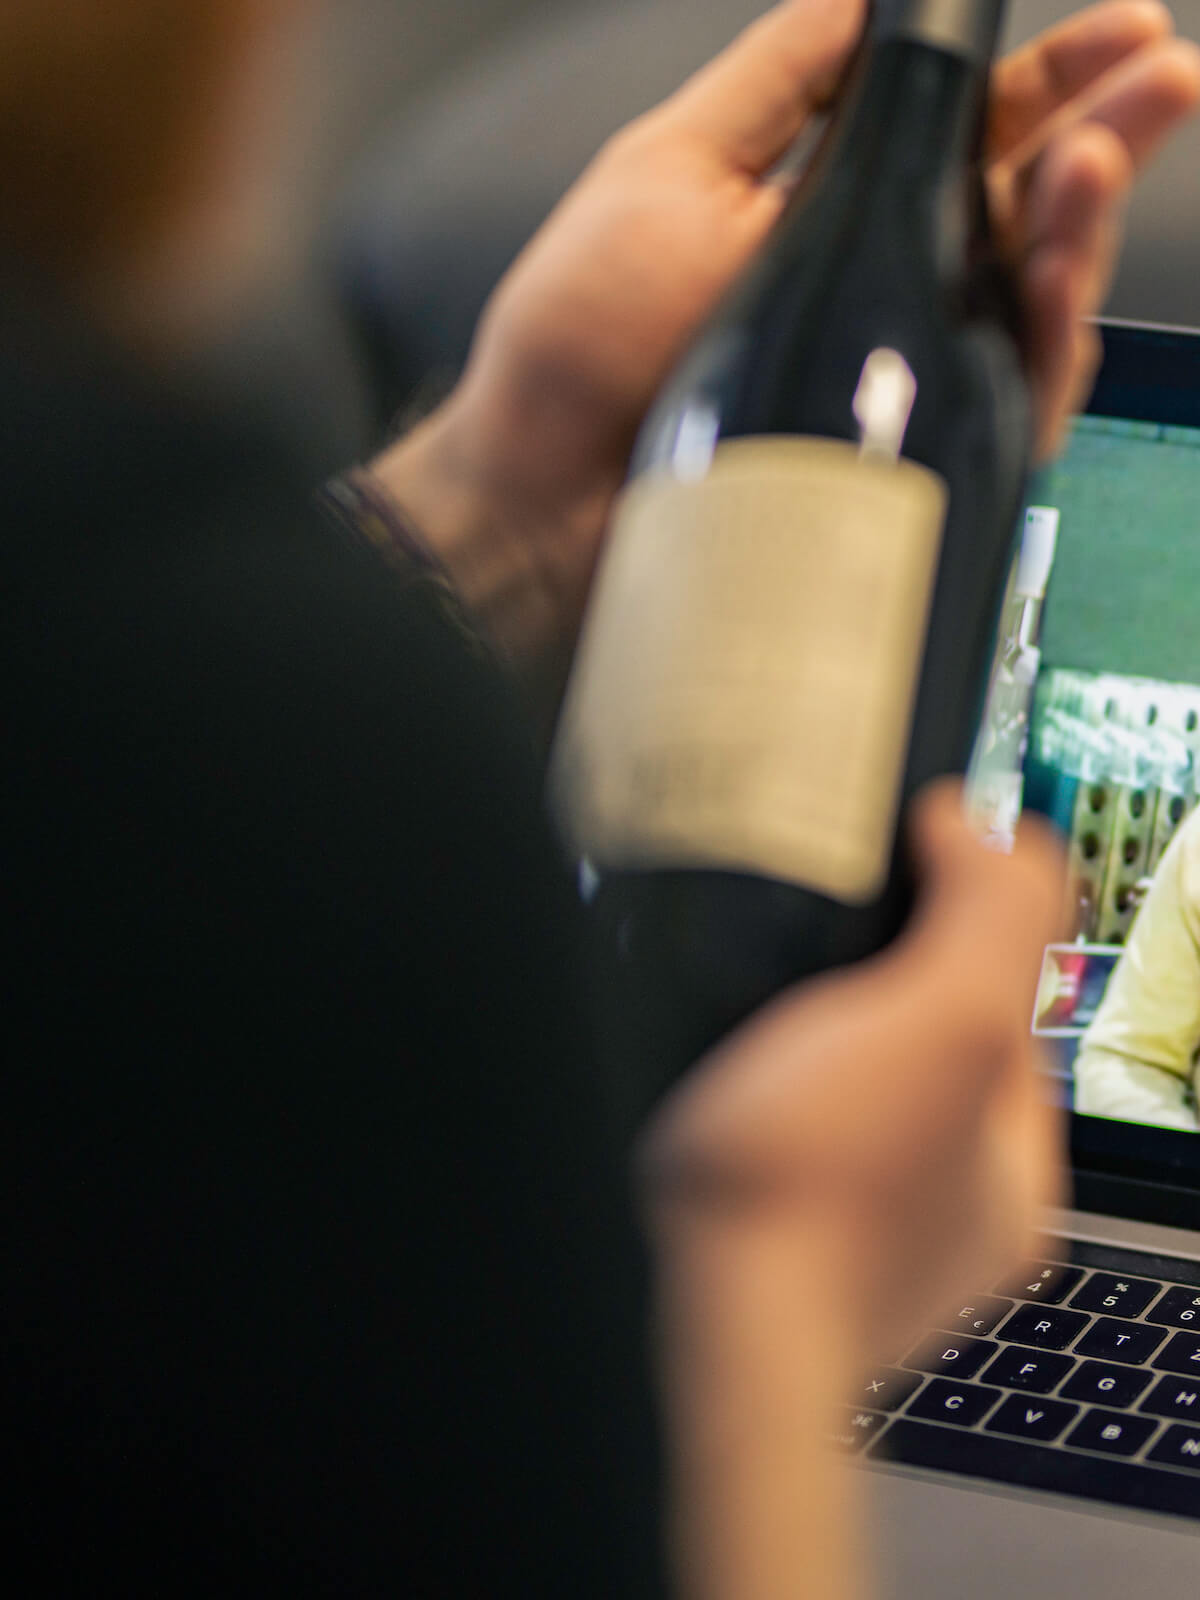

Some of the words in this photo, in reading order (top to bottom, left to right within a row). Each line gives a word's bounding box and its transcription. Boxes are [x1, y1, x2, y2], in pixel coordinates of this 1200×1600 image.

[1026, 1282, 1042, 1292] 4
[1102, 1295, 1119, 1307] 5
[957, 1306, 975, 1318] E
[1180, 1309, 1196, 1321] 6
[972, 1320, 984, 1328] €
[1034, 1320, 1052, 1333] R
[1116, 1334, 1131, 1346] T
[940, 1348, 960, 1361] D
[1019, 1363, 1037, 1375] F
[864, 1379, 885, 1393] X
[1097, 1377, 1116, 1391] G
[944, 1395, 964, 1409] C
[1175, 1391, 1197, 1405] H
[1025, 1409, 1044, 1423] V
